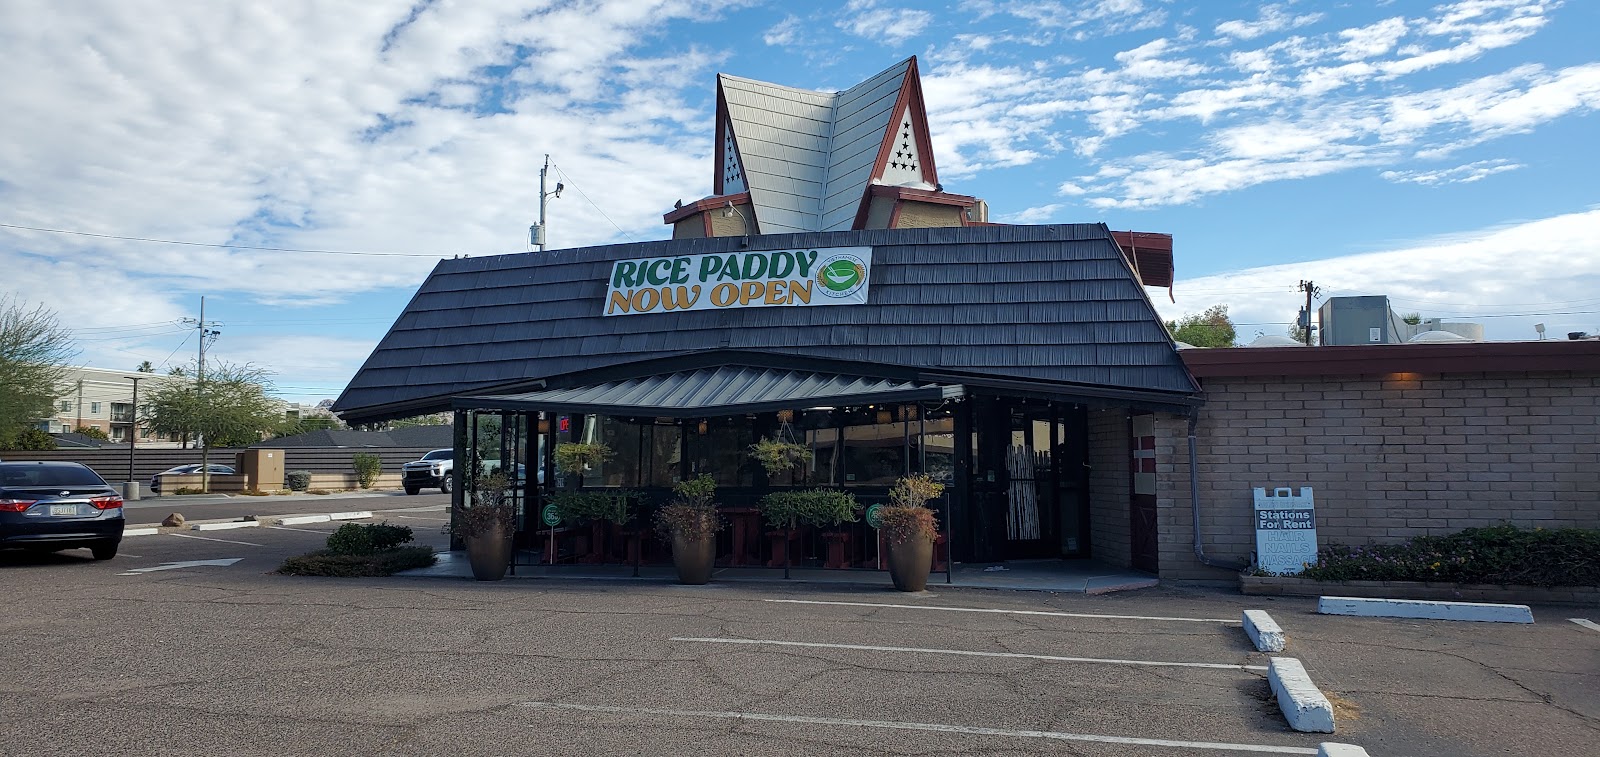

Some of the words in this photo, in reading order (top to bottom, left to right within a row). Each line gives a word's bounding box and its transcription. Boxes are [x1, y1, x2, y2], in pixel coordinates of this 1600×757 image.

[827, 255, 858, 263] VIETNAMESE
[613, 257, 691, 288] RICE
[698, 251, 818, 282] PADDY
[608, 285, 701, 314] NOW
[710, 280, 814, 307] OPEN
[826, 289, 853, 297] KITCHEN
[1260, 510, 1310, 519] Stations
[1260, 520, 1280, 529] For
[1283, 520, 1312, 529] Rent
[1267, 531, 1305, 541] HAIR
[1264, 543, 1310, 553] NAILS
